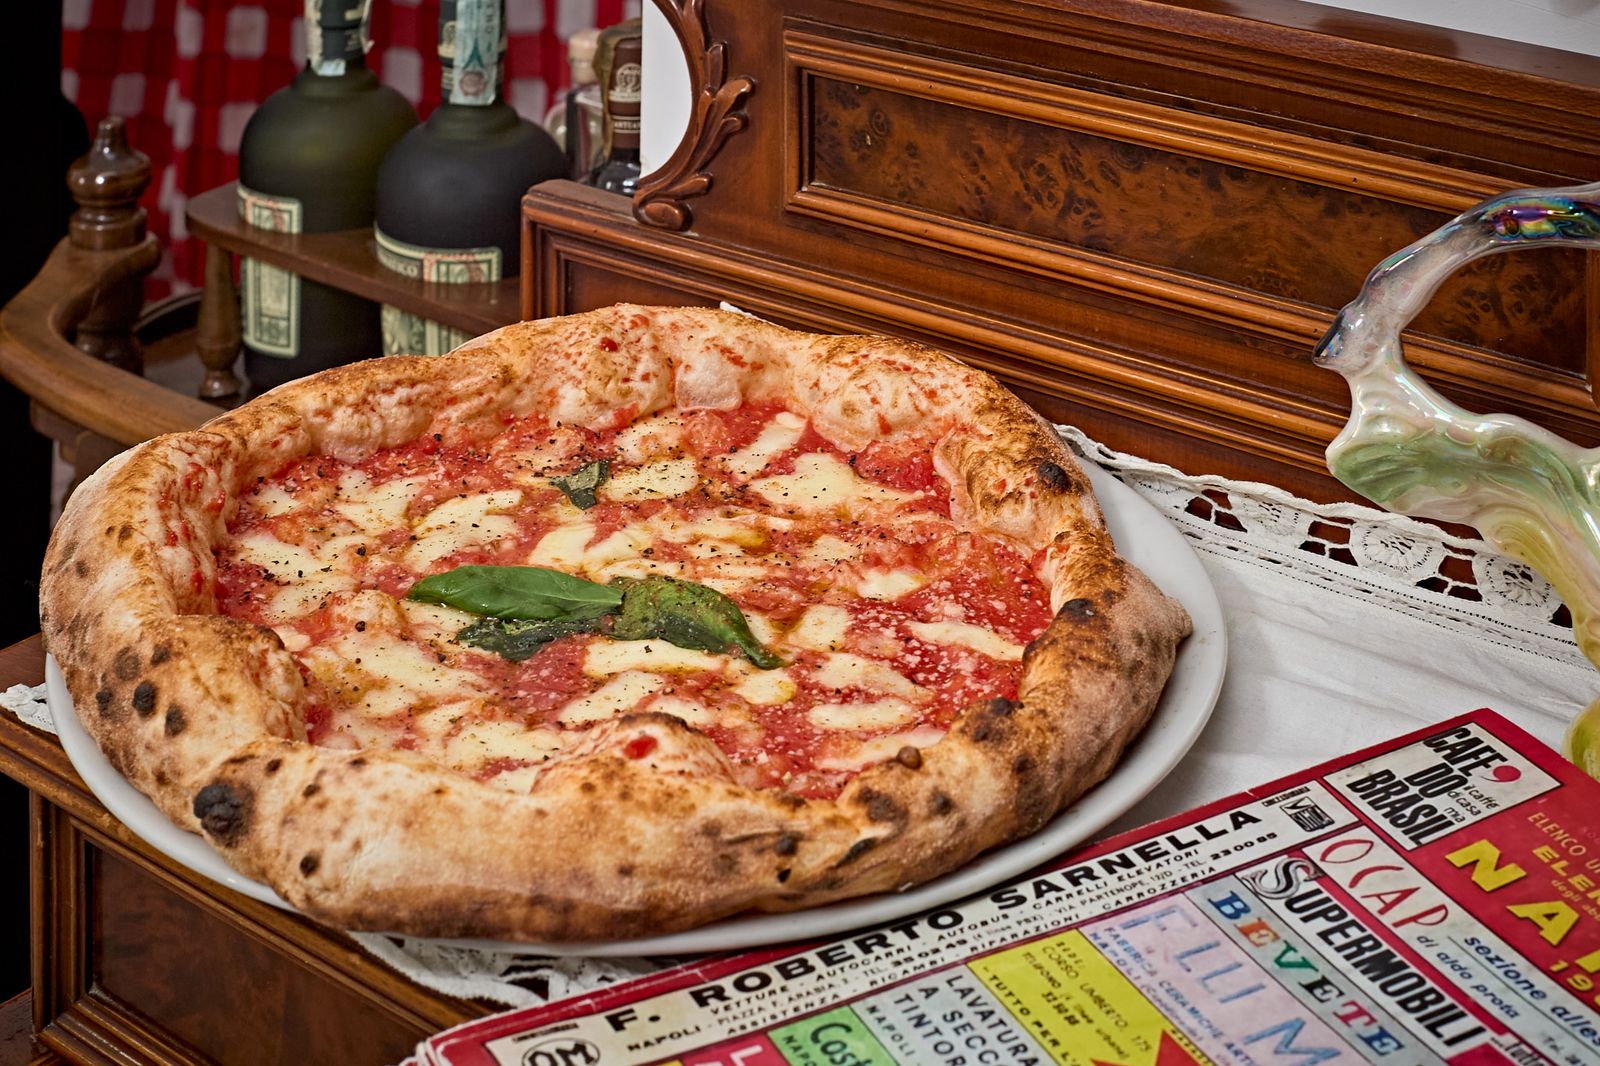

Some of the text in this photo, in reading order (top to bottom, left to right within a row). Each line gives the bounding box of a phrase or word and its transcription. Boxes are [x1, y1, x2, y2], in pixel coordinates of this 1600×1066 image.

[1346, 769, 1455, 847] BRASIL
[1403, 762, 1468, 798] DO
[1456, 797, 1482, 816] casa
[1527, 812, 1587, 856] ELENCO
[604, 811, 1262, 1032] F. ROBERTO SARNELLA
[1320, 839, 1449, 928] OCAP
[1445, 839, 1600, 974] NA
[711, 849, 1199, 1015] VETTURE AUTOCARRI AUTOBUS CARRELLI ELEVATORI
[727, 867, 1217, 1035] ASSISTENZA RICAMBI RIPARAZIONI CARROZZERIA
[1042, 946, 1080, 979] CORSO
[1089, 932, 1141, 980] NAPOLI
[1103, 926, 1158, 977] FABBRICA
[1240, 854, 1487, 1047] SUPERMOBILI
[1464, 936, 1548, 1000] sezione
[989, 974, 1031, 1016] TUTTO
[1032, 1020, 1061, 1048] PER
[1208, 890, 1405, 1056] BEVETE
[1416, 935, 1520, 1019] di aldo prota
[1549, 960, 1600, 1007] 19
[627, 1025, 701, 1051] NAPOLI
[866, 1005, 915, 1056] NAPOLI
[918, 986, 999, 1066] A SECC
[945, 975, 1039, 1066] LAVATURA
